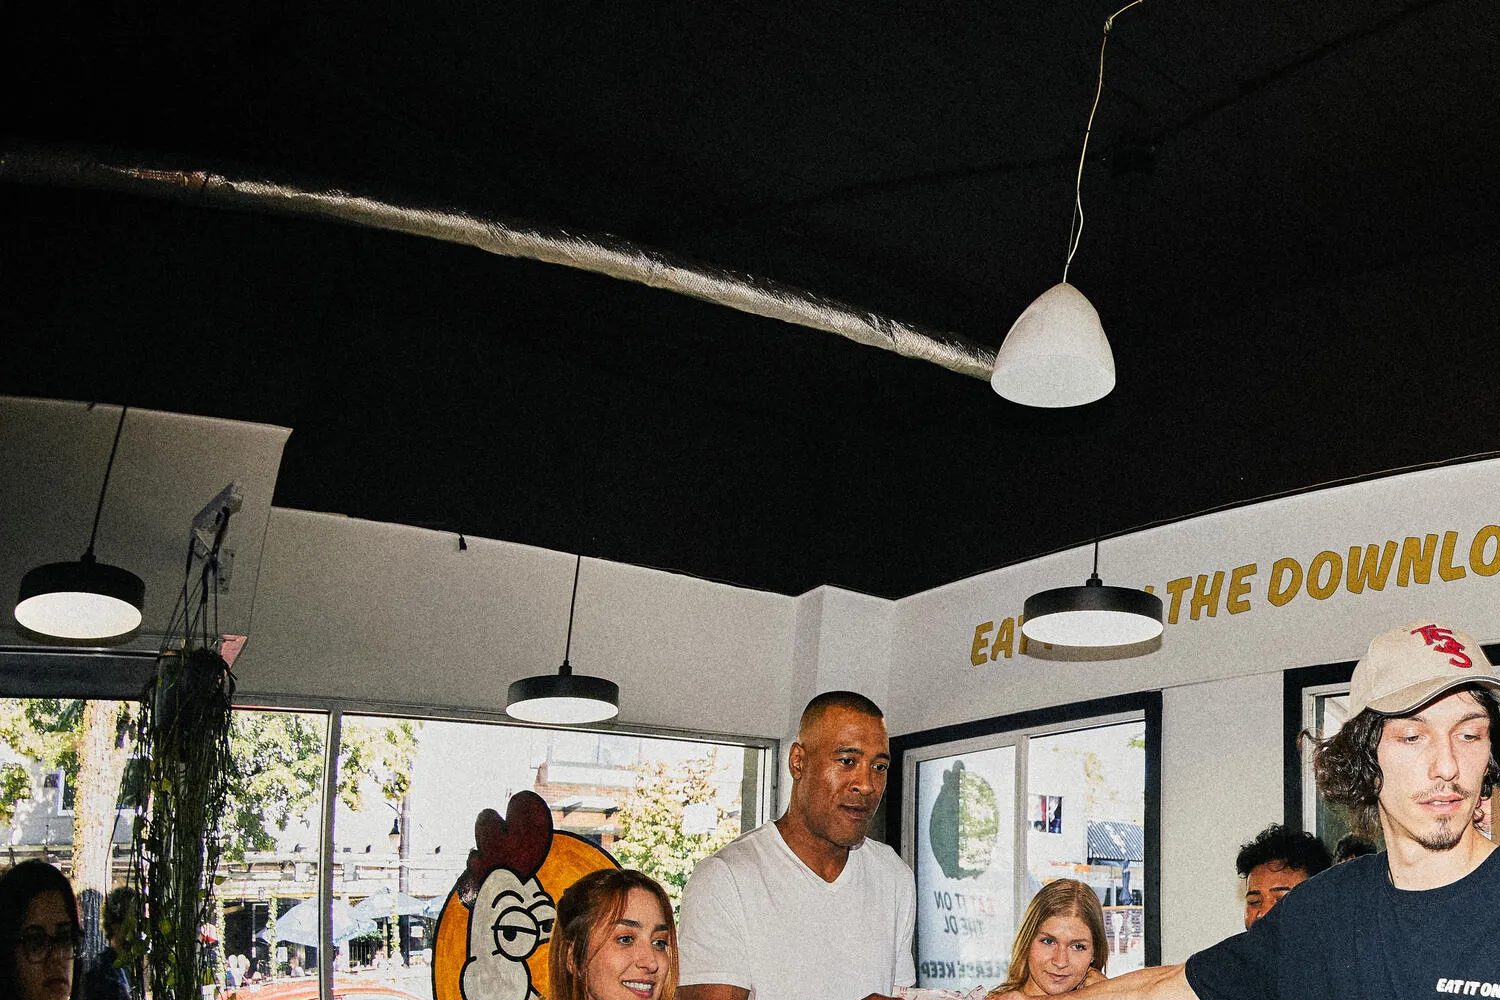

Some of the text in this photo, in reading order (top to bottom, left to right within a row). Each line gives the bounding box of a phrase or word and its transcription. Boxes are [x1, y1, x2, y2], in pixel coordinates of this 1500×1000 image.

[1166, 562, 1258, 625] THE
[1436, 977, 1464, 994] EAT
[1463, 980, 1480, 996] IT
